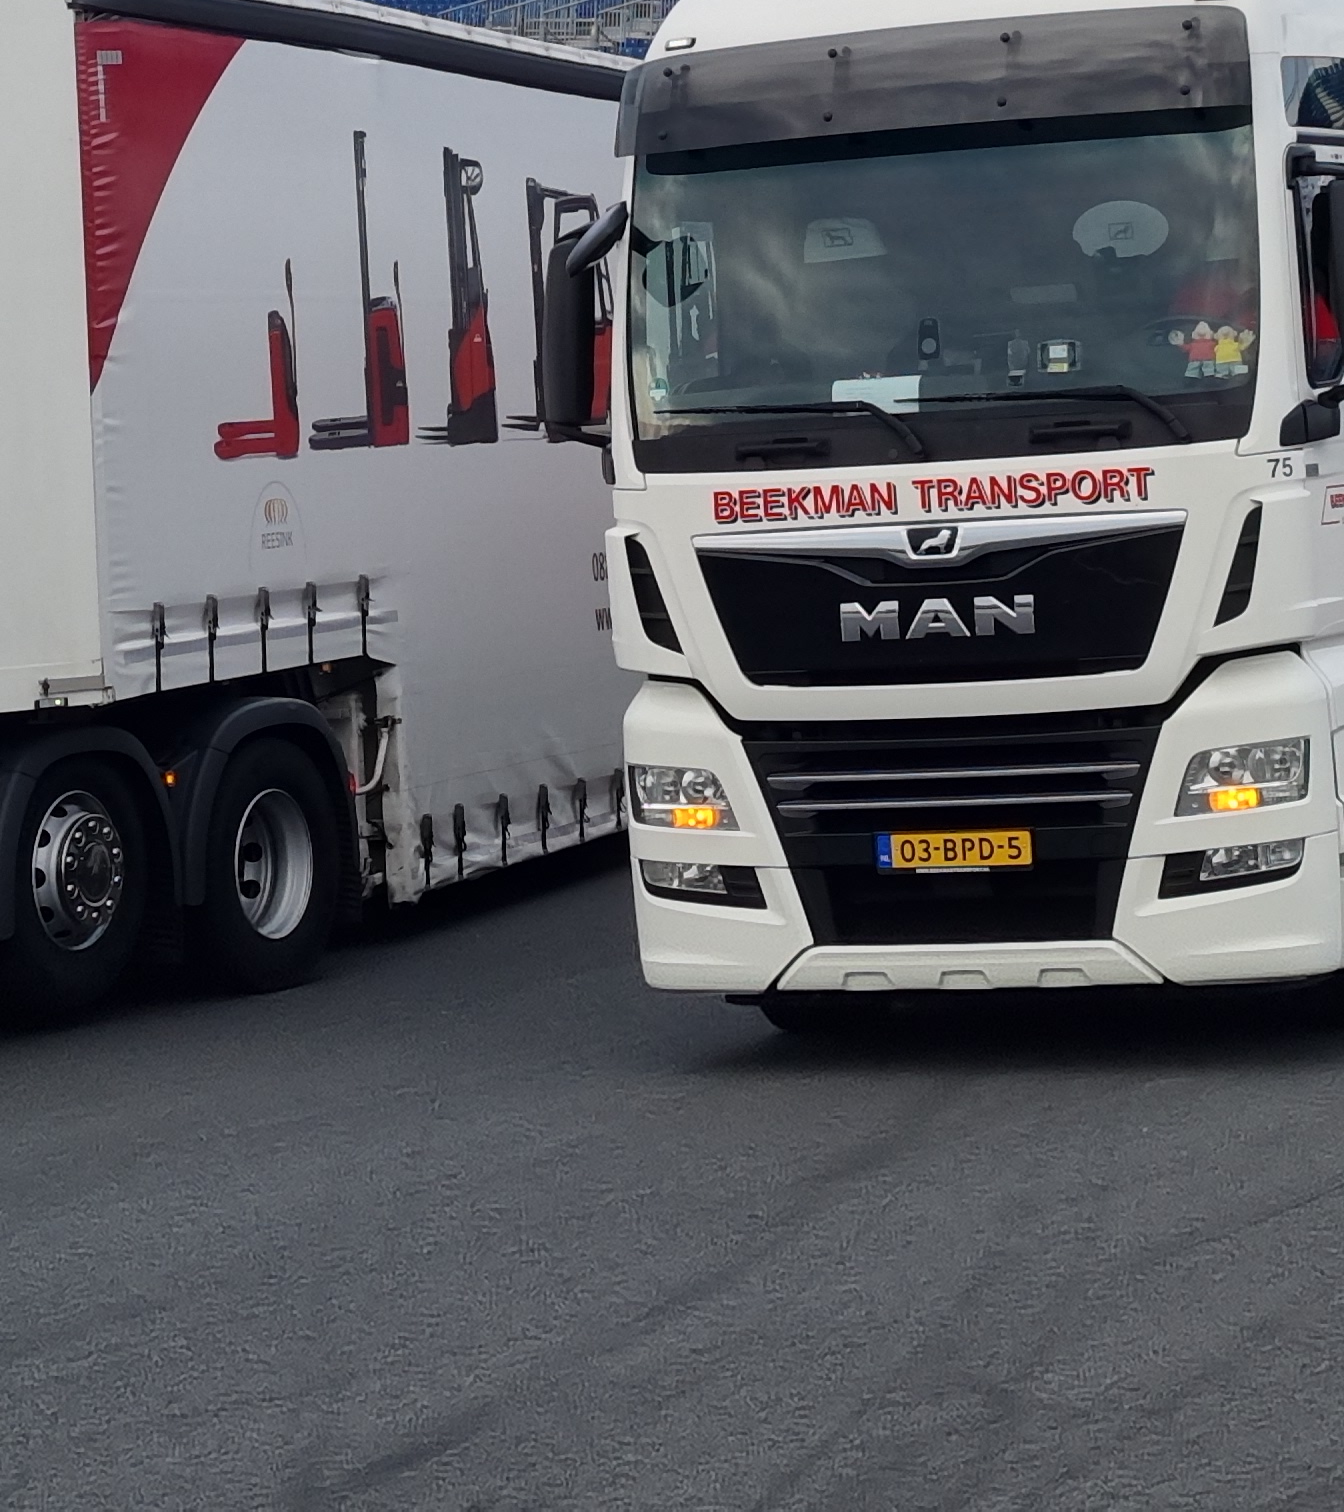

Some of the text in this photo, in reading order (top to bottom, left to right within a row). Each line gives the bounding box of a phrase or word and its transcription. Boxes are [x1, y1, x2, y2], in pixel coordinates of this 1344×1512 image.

[1266, 456, 1293, 478] 75
[713, 466, 1155, 524] BEEKMAN TRANSPORT
[261, 531, 293, 550] REESINK
[839, 594, 1036, 642] MAN
[900, 836, 1023, 863] 03-BPD-5
